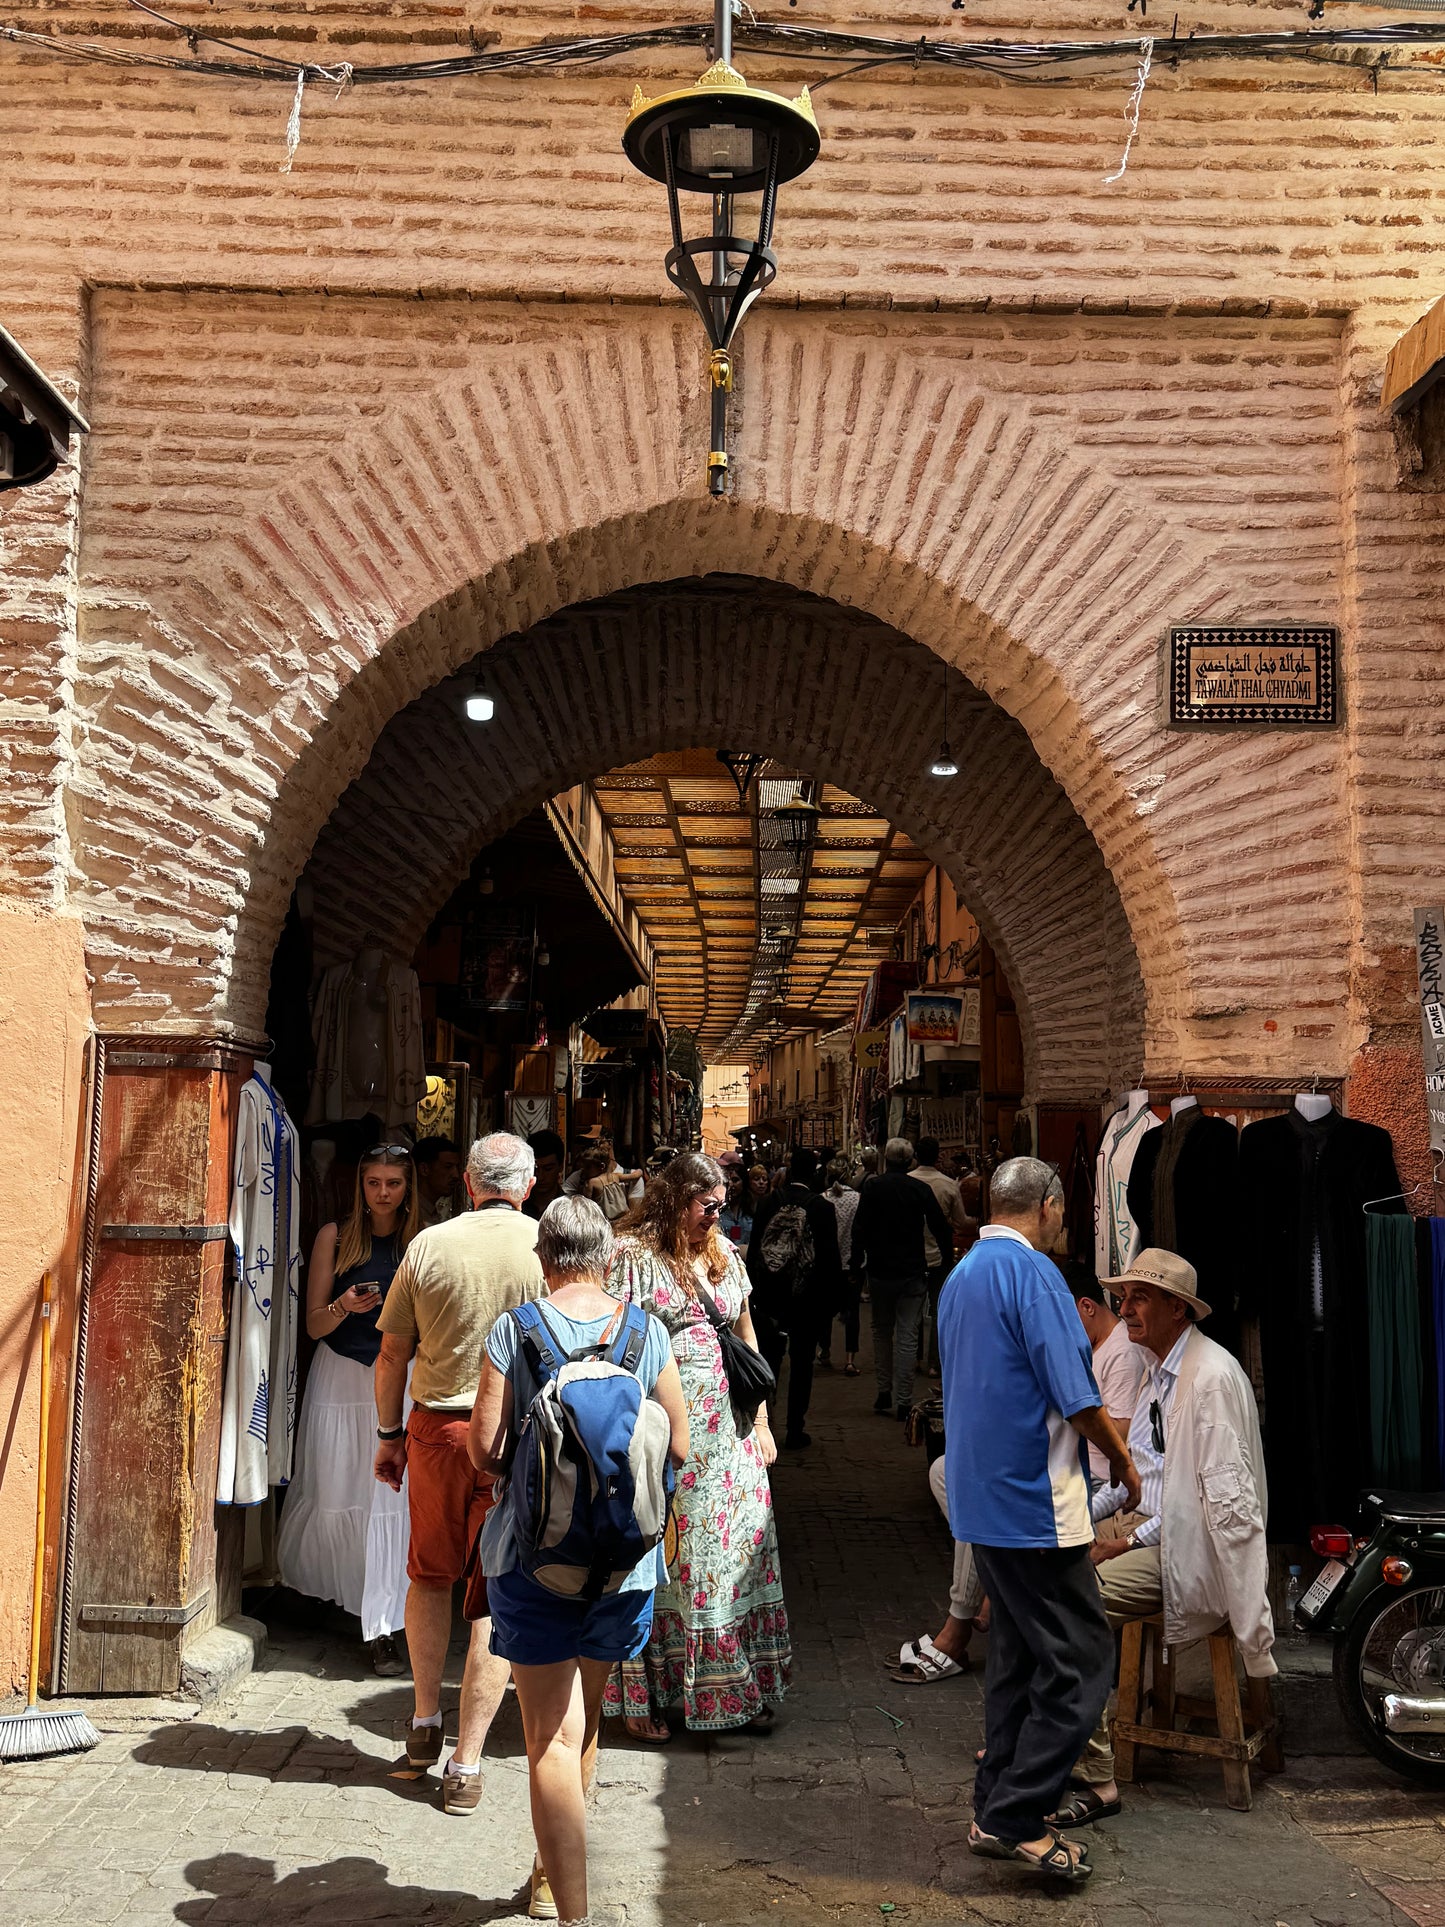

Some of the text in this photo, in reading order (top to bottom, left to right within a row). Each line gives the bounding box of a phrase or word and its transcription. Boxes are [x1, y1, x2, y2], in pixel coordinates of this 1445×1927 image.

[1280, 650, 1312, 679] طوالة
[1195, 679, 1311, 699] TAWALAT FHAL CHYADMI
[1429, 1004, 1444, 1035] ACME
